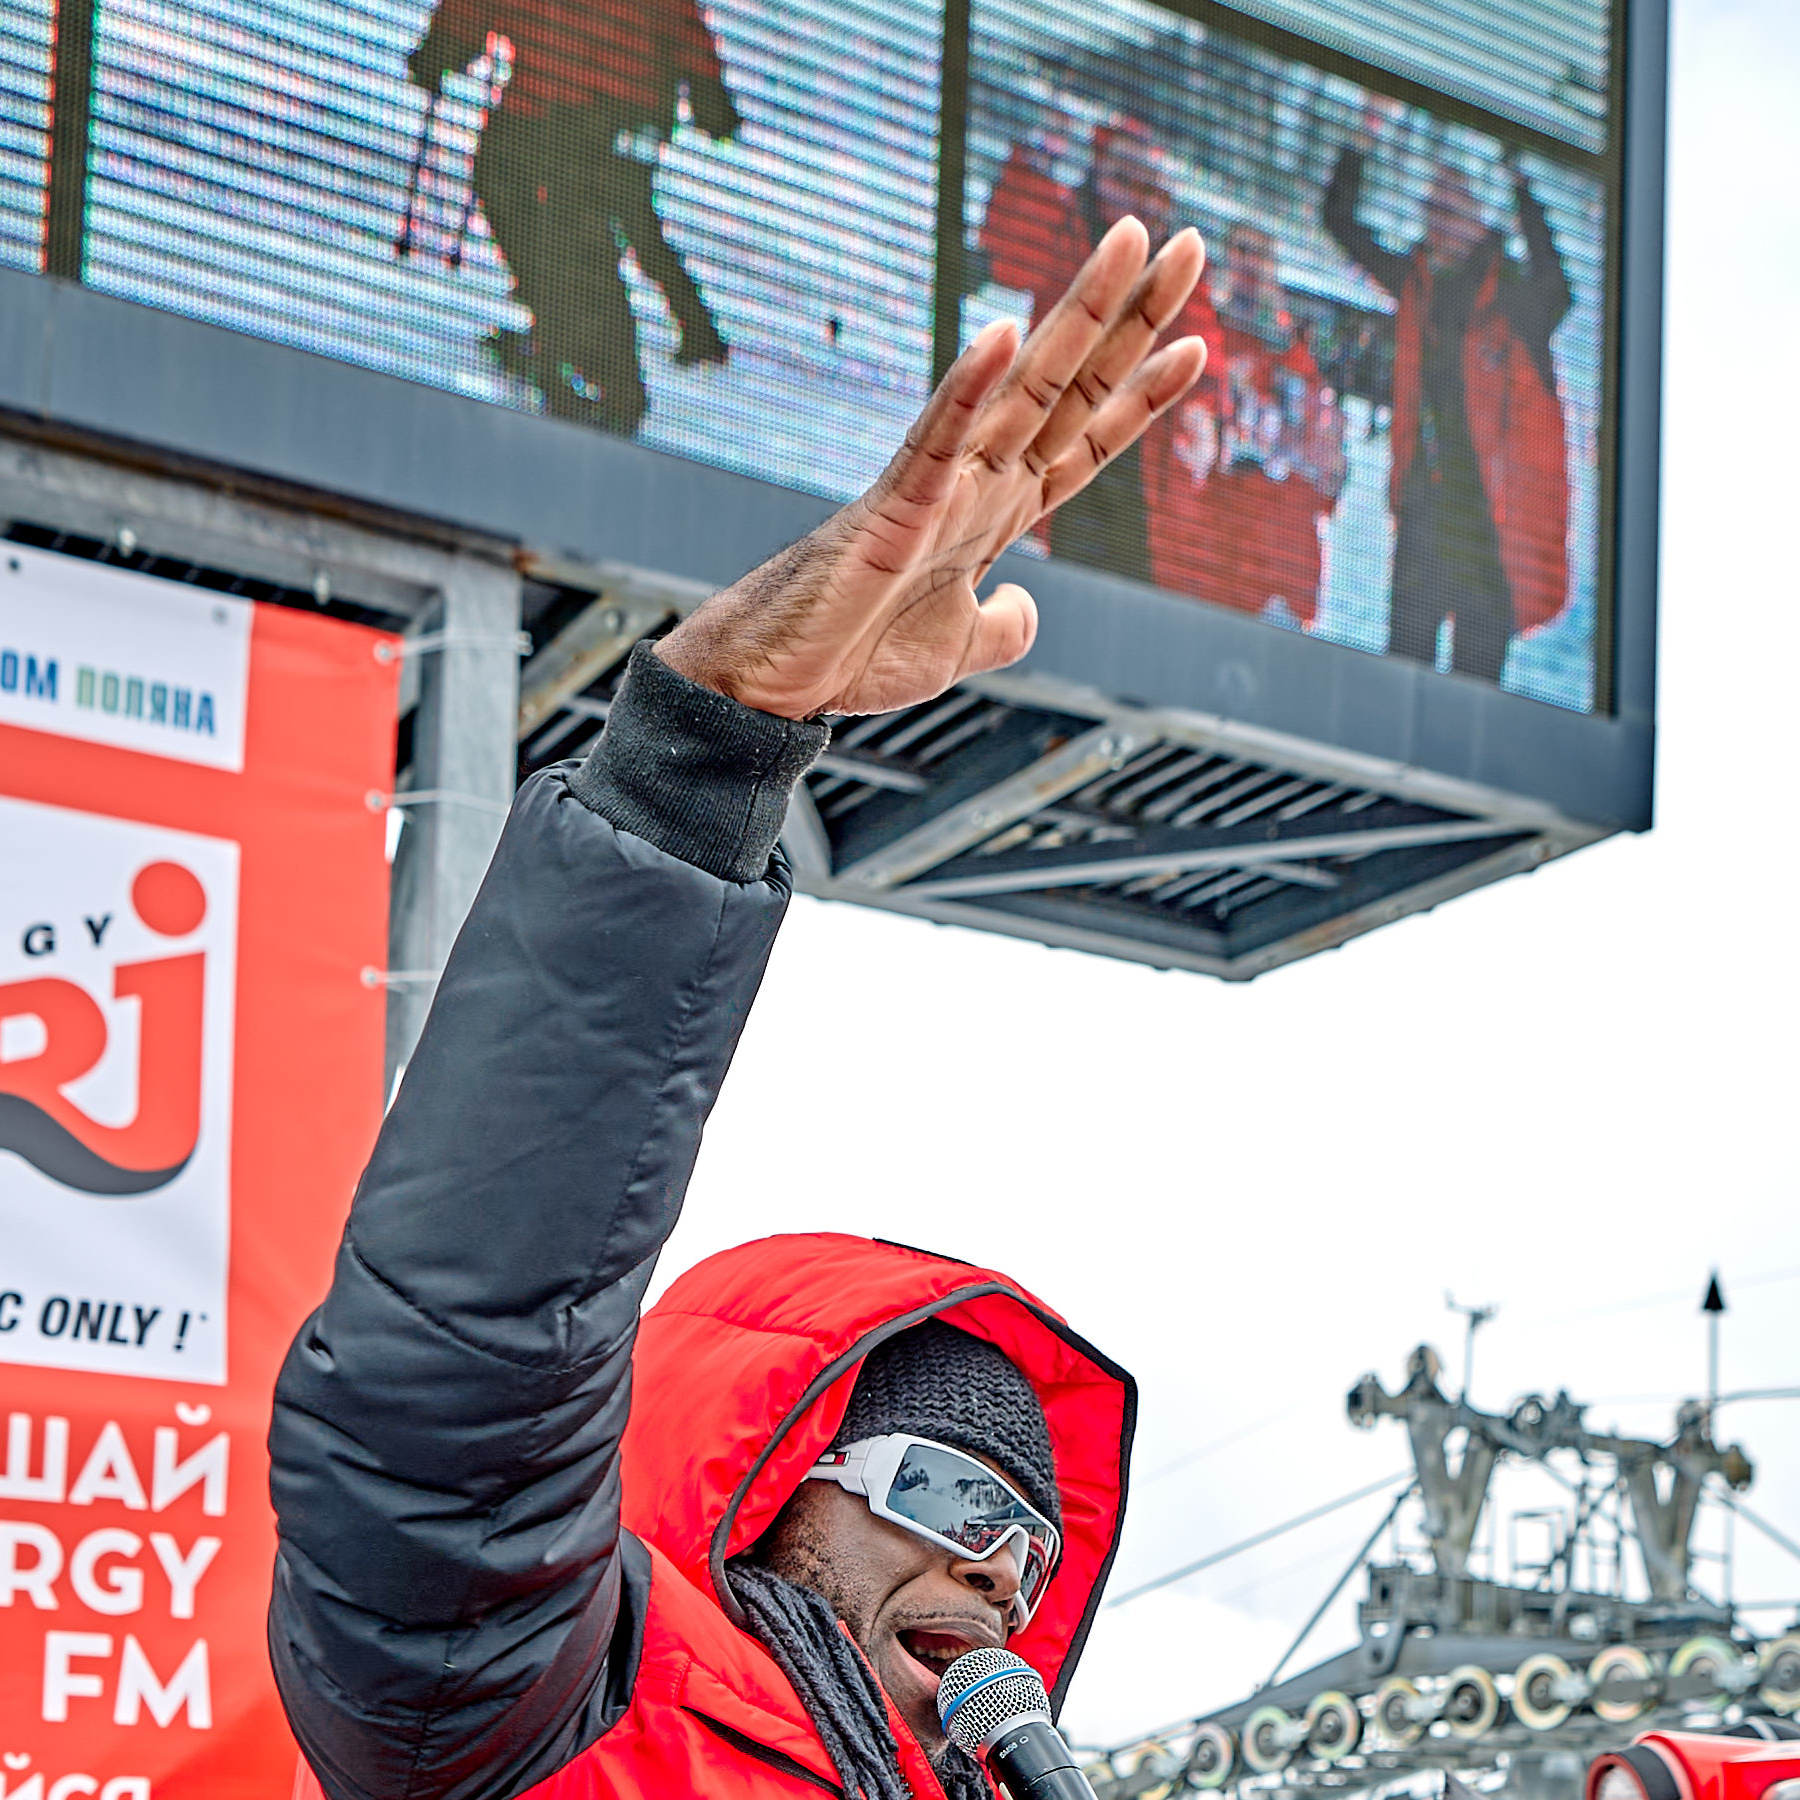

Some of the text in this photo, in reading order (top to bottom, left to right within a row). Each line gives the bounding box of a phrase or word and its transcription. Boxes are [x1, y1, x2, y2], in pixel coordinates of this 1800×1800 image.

[76, 667, 219, 738] ПОЛЯНА
[39, 1294, 164, 1348] ONLY
[41, 1630, 212, 1729] FM
